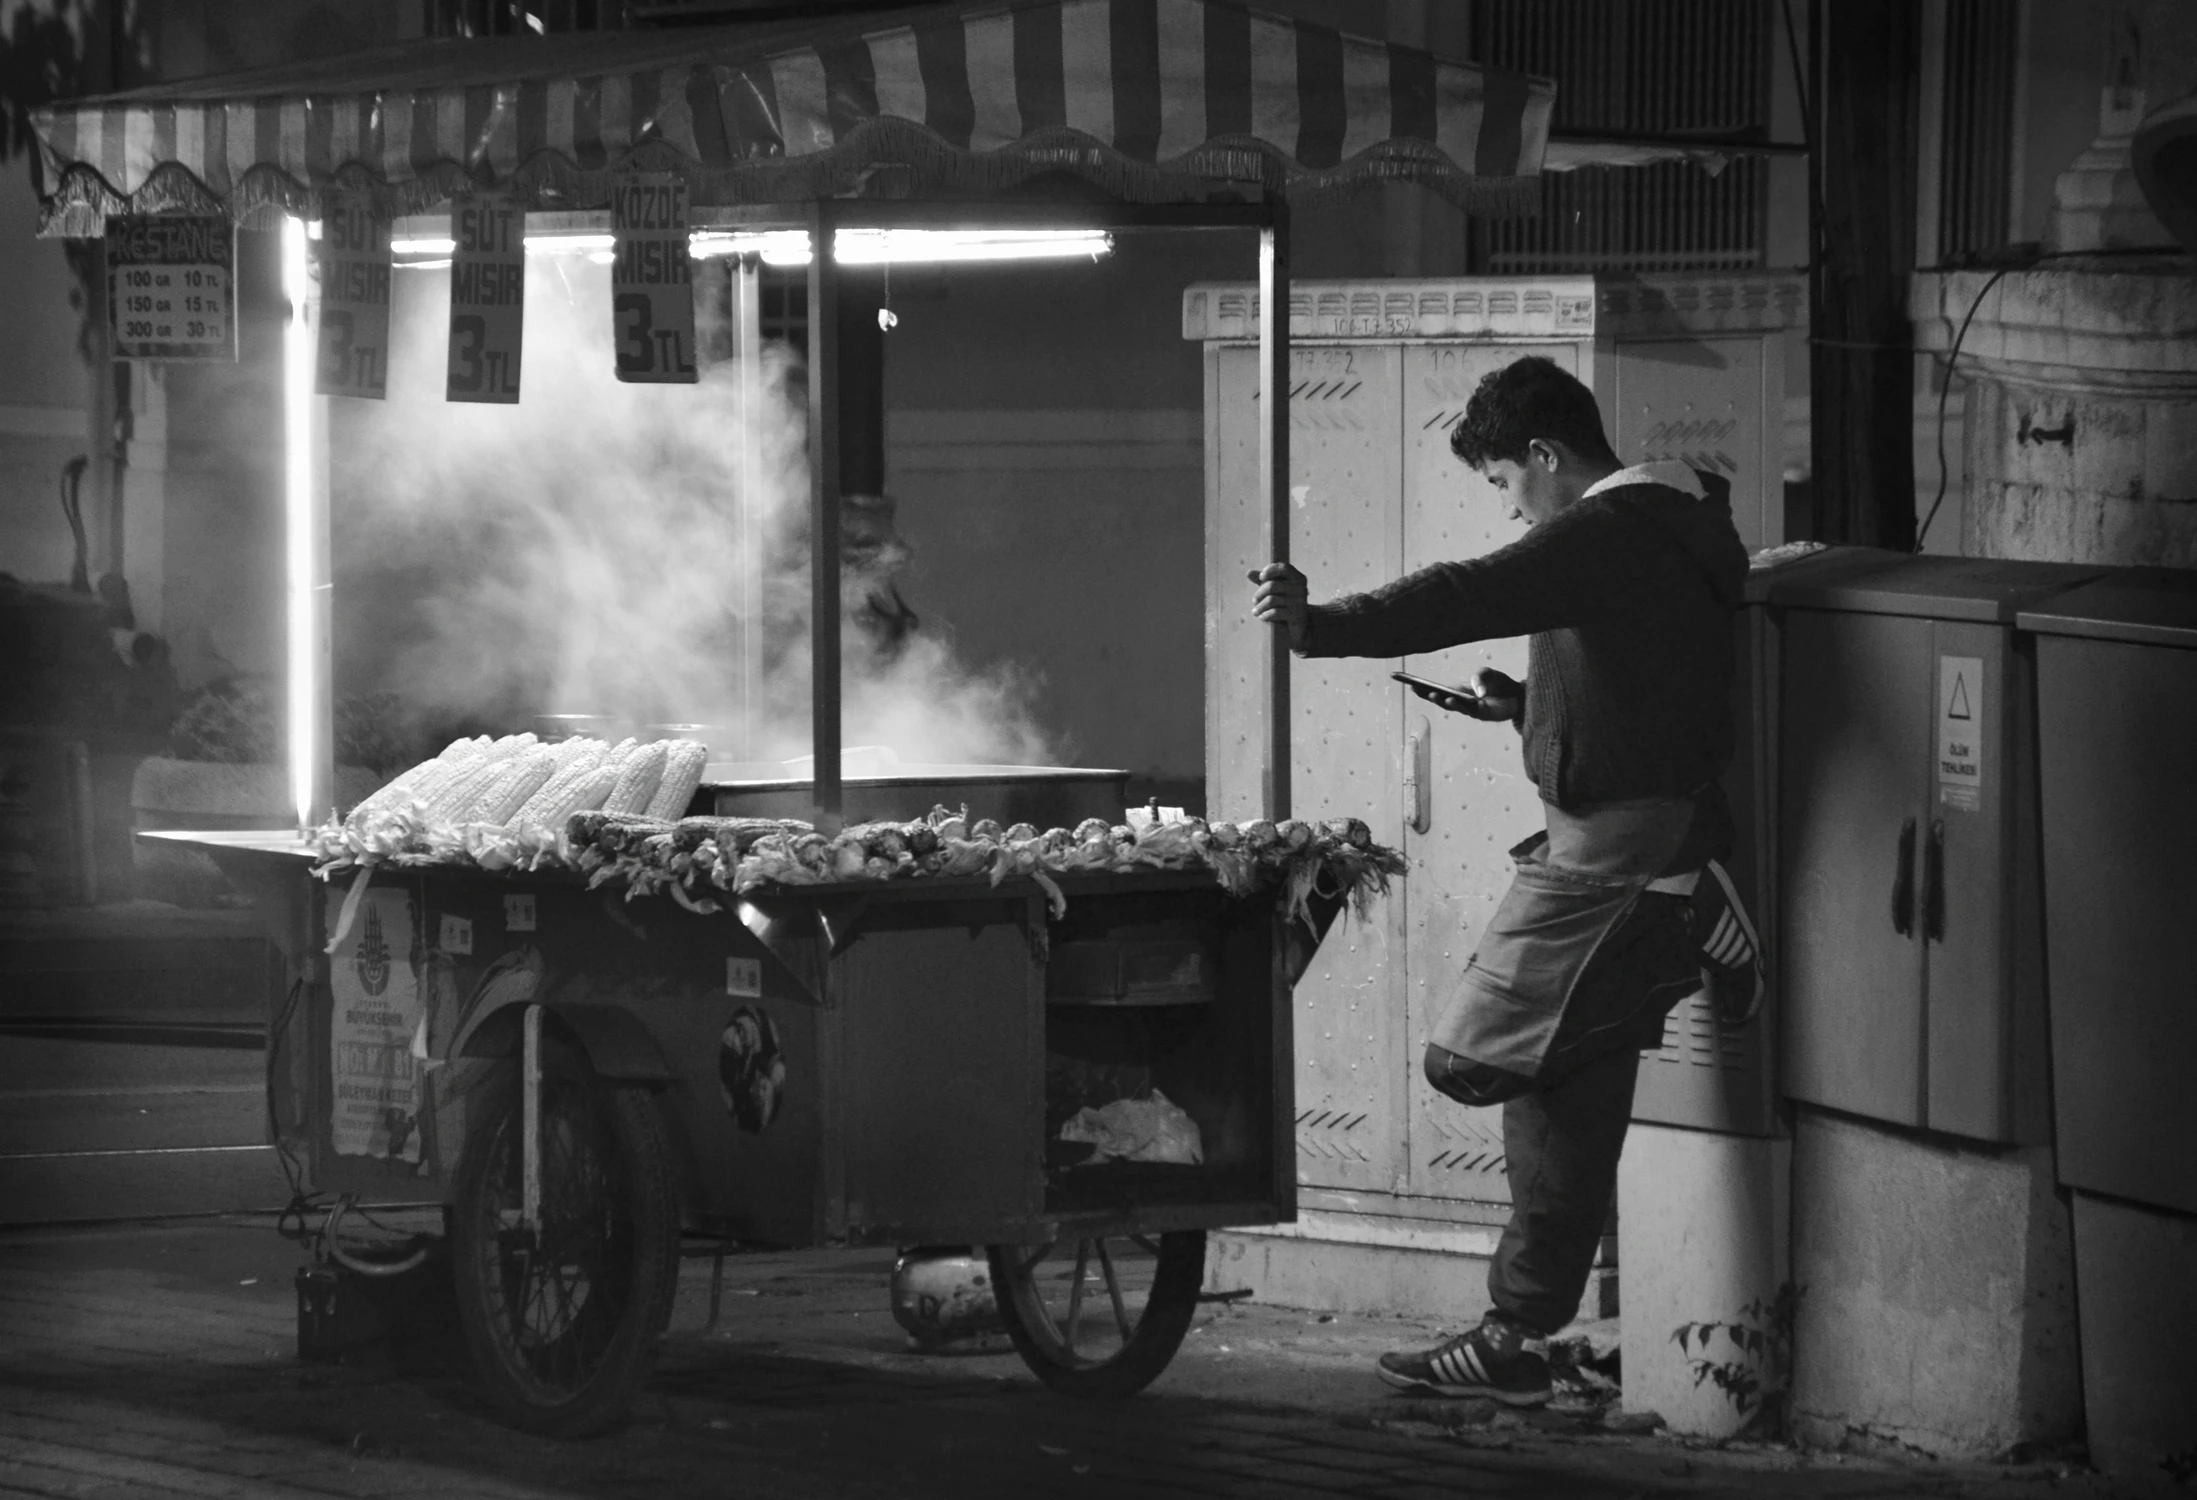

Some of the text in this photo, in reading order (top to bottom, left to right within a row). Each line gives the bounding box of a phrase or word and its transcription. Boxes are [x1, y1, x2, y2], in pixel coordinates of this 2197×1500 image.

[116, 225, 226, 260] KESTANE
[462, 201, 512, 252] SÜT
[126, 270, 218, 288] 100 GR 10 TL
[326, 262, 389, 304] MISIR
[614, 240, 691, 284] MISIR
[126, 295, 219, 313] 150 GR 15 TL
[452, 264, 520, 305] MISIR
[126, 320, 221, 338] 300 GR 30 TL
[321, 310, 384, 388] 3 TL
[615, 294, 694, 373] 3 TL
[449, 315, 516, 393] 3 TL
